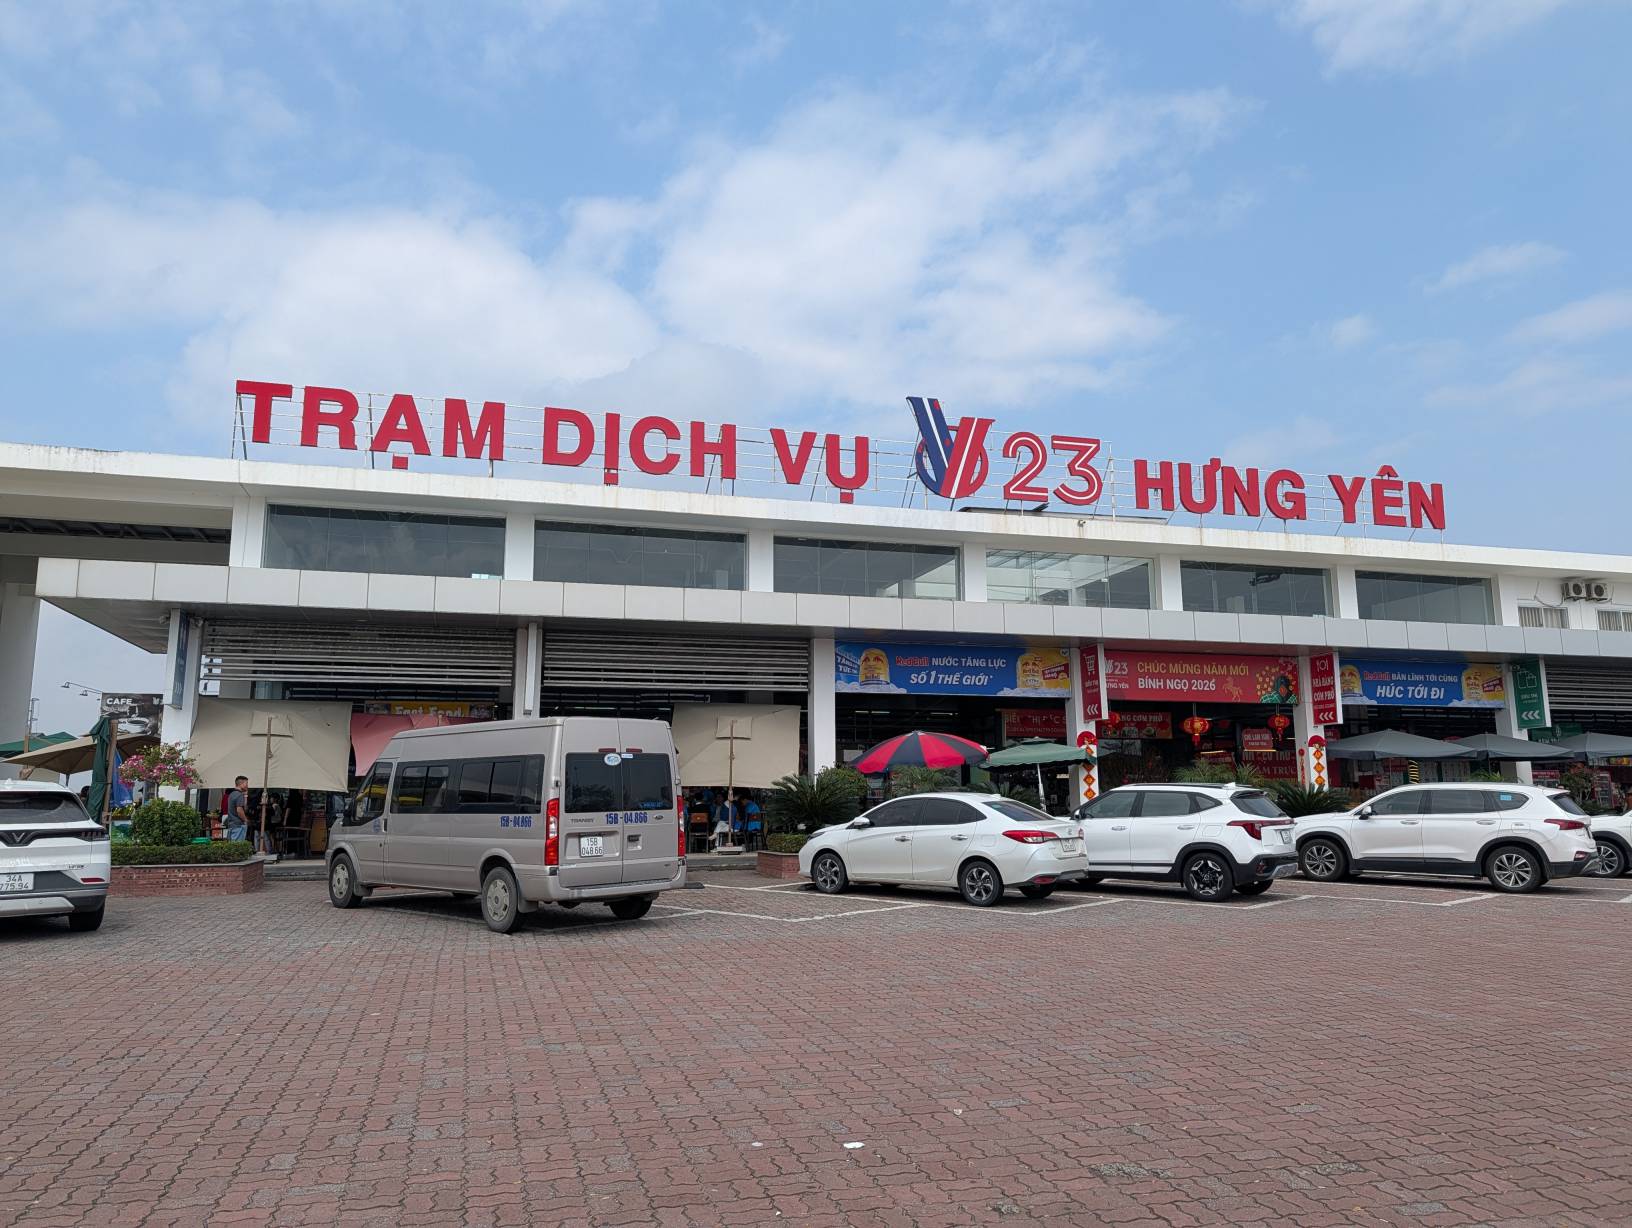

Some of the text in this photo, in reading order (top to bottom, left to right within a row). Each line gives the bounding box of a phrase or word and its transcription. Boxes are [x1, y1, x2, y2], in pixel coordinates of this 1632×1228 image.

[236, 380, 505, 469] TRẠM
[543, 406, 737, 485] DỊCH
[770, 428, 869, 504] VỤ
[1003, 431, 1102, 506] 23
[1134, 457, 1306, 521] HƯNG
[1328, 464, 1446, 530] YÊN
[931, 656, 959, 666] NƯỚC
[961, 657, 986, 668] TĂNG
[988, 659, 1006, 670] LỰC
[1137, 659, 1249, 676] CHÚC MỪNG NĂM MỚI
[910, 671, 929, 684] SỐ
[929, 670, 936, 685] 1
[937, 671, 962, 685] THẾ
[1138, 675, 1216, 693] BÍNH NGỌ 2026
[1376, 683, 1445, 700] HÚC TỚI ĐI
[106, 697, 133, 705] CAFE
[6, 874, 23, 883] 34A
